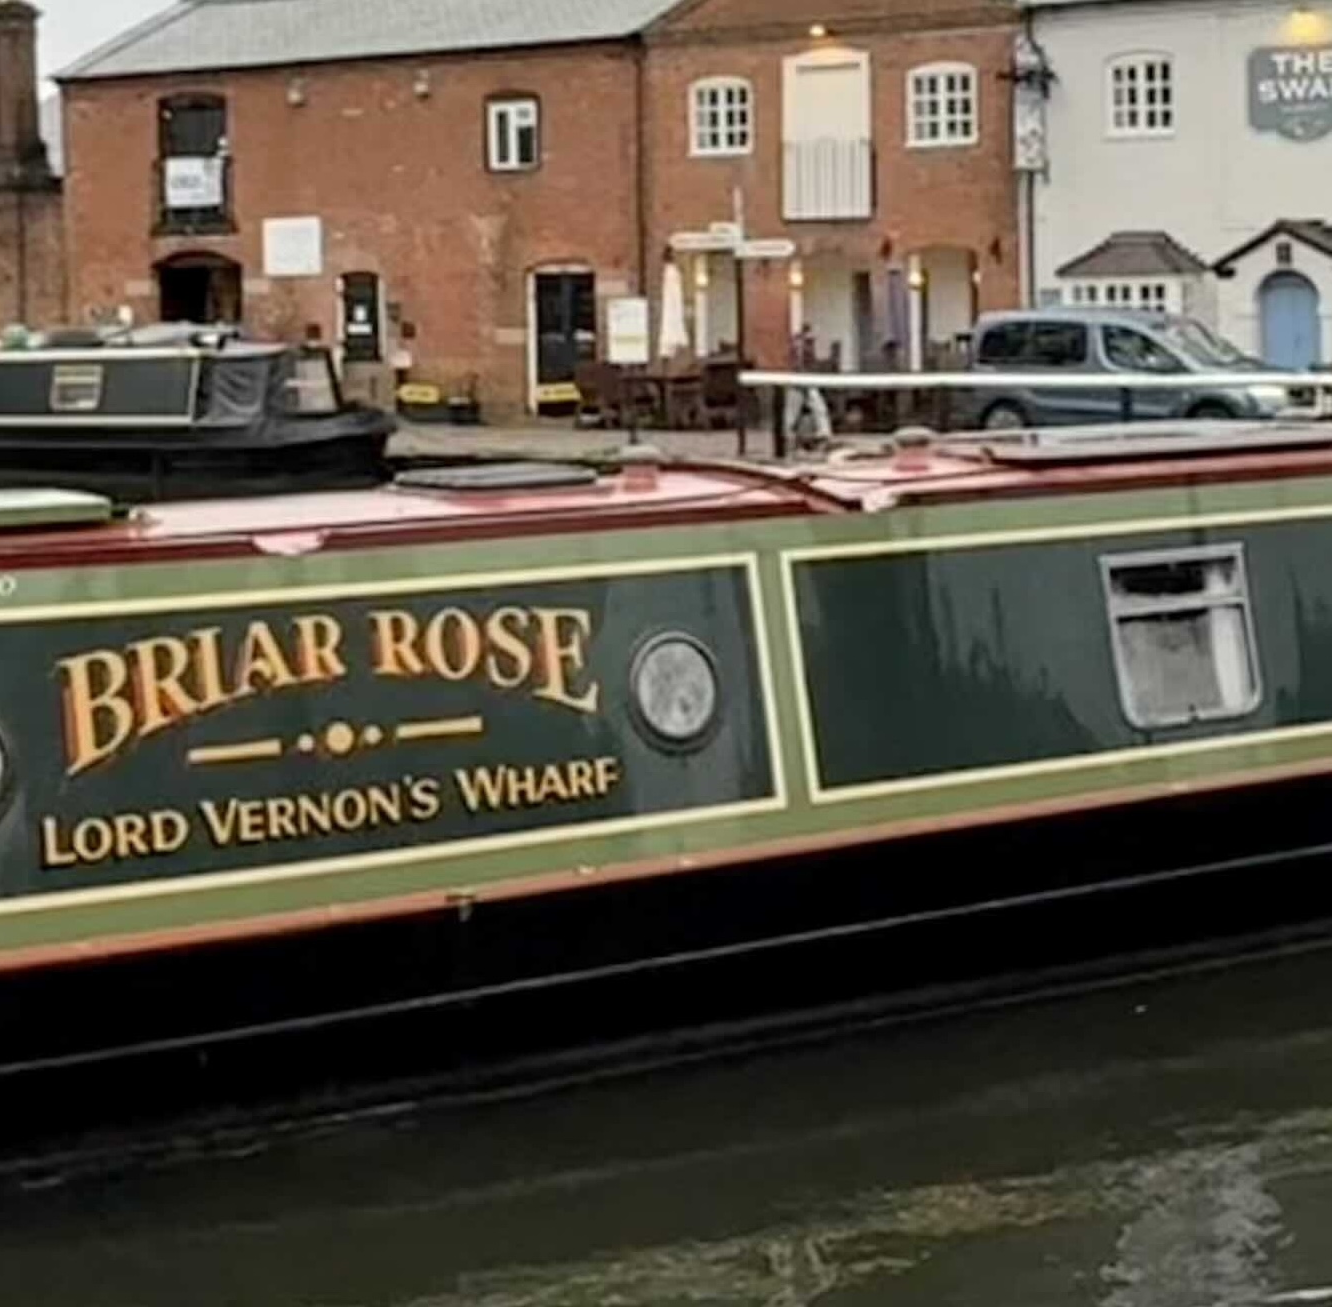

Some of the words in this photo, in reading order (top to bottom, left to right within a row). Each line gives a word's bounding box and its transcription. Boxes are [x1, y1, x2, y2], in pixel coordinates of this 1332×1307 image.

[52, 614, 349, 776] BRIAR
[368, 605, 599, 713] ROSE
[40, 808, 189, 869] LORD
[200, 774, 442, 846] VERNON'S
[453, 756, 621, 811] WHARF
